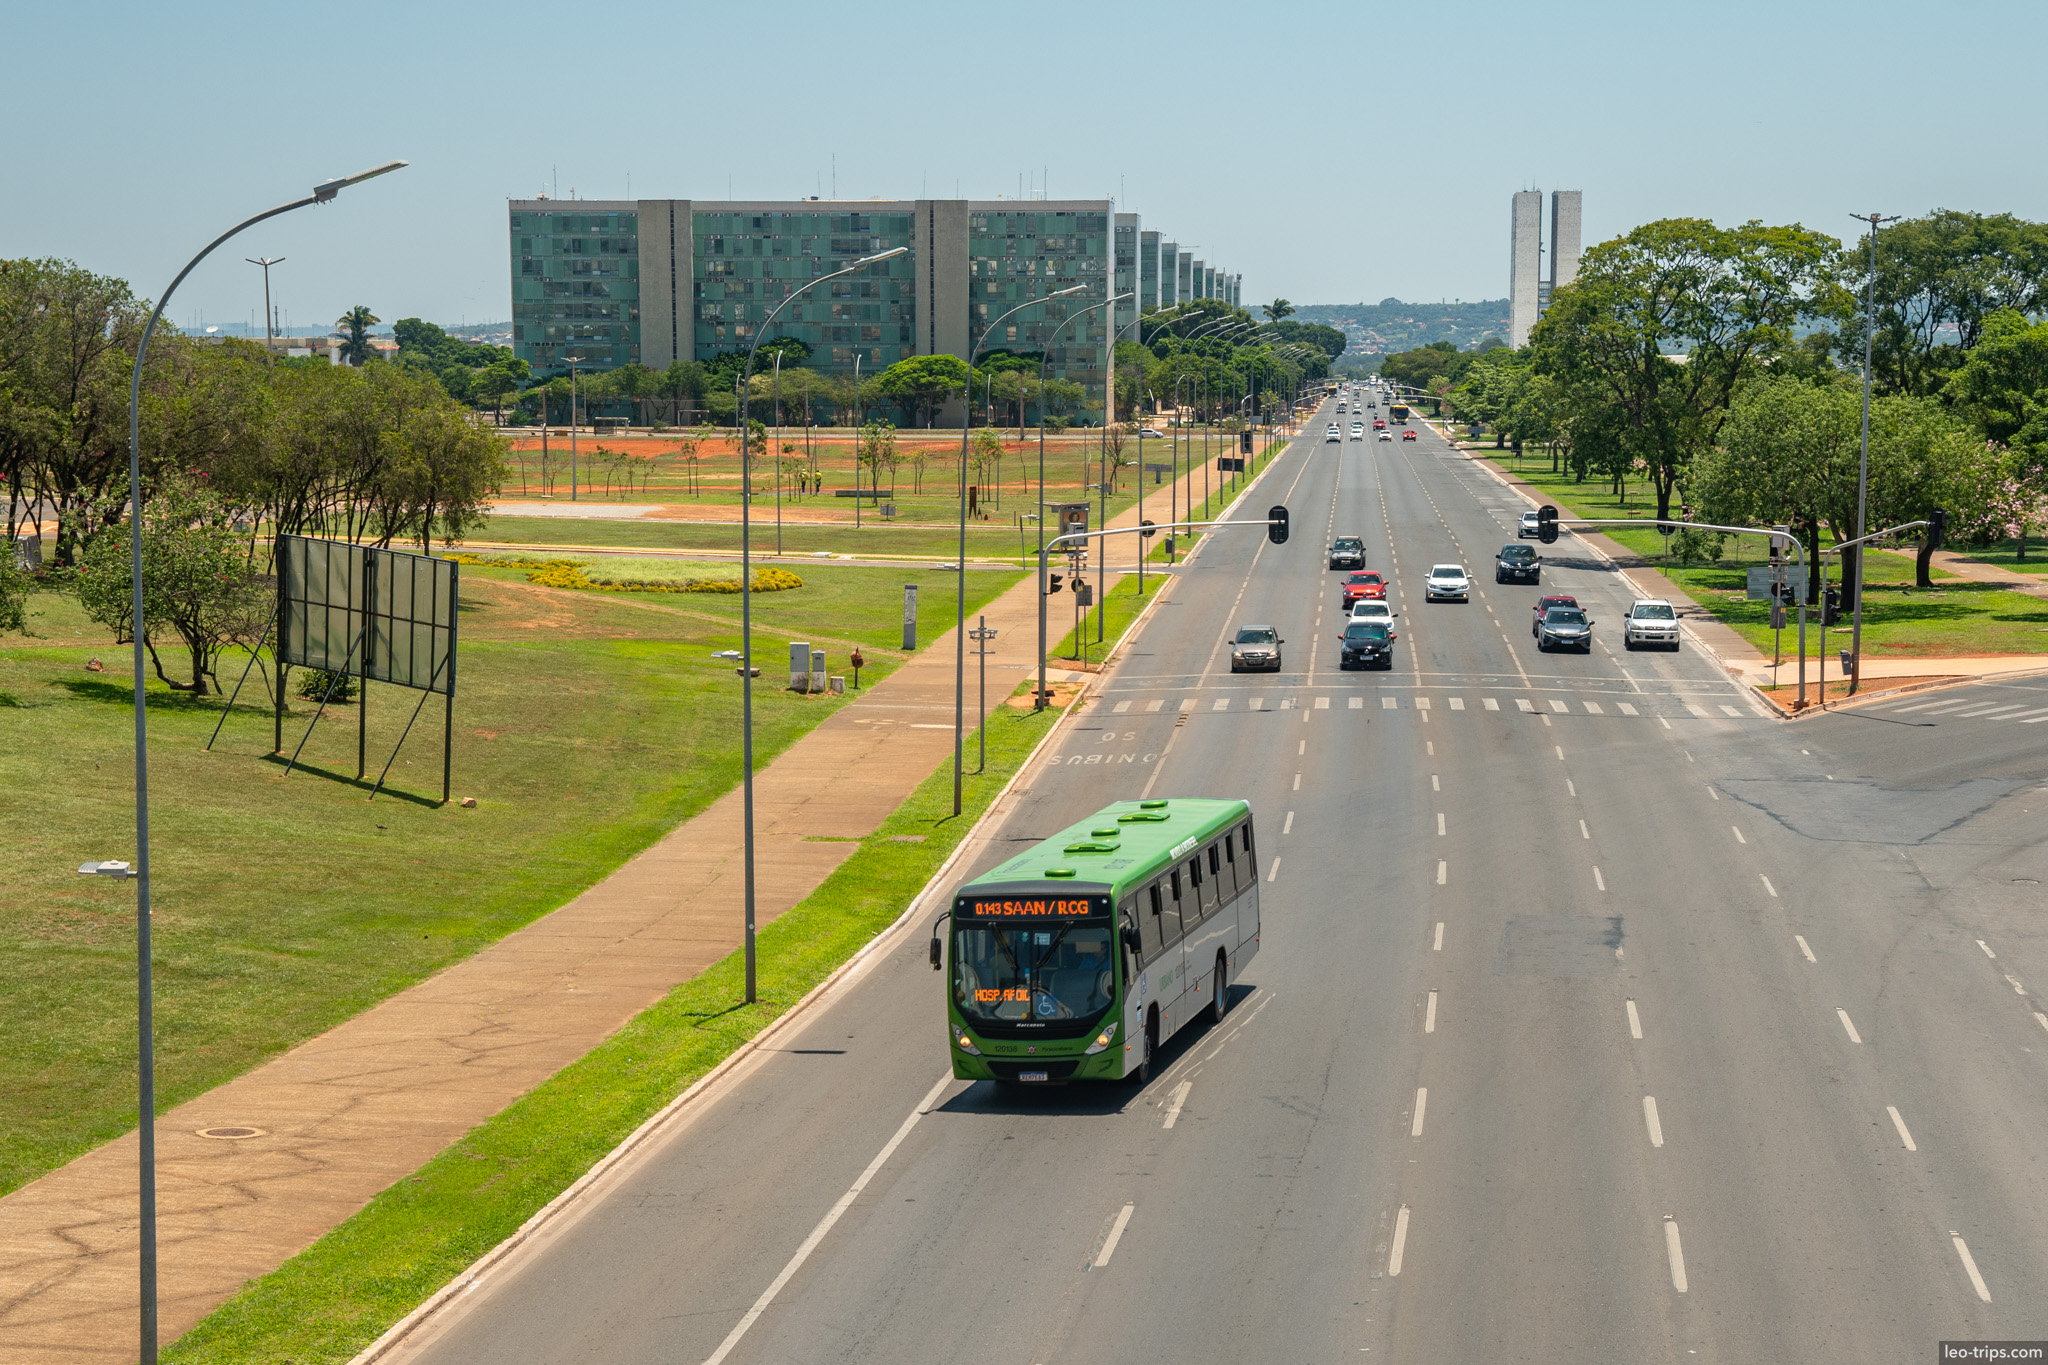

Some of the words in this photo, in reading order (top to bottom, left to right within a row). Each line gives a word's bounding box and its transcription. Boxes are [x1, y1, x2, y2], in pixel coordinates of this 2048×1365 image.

[975, 902, 1001, 915] 0.143
[1003, 901, 1045, 915] SAAN
[1048, 901, 1055, 915] /
[1058, 900, 1089, 914] RCG
